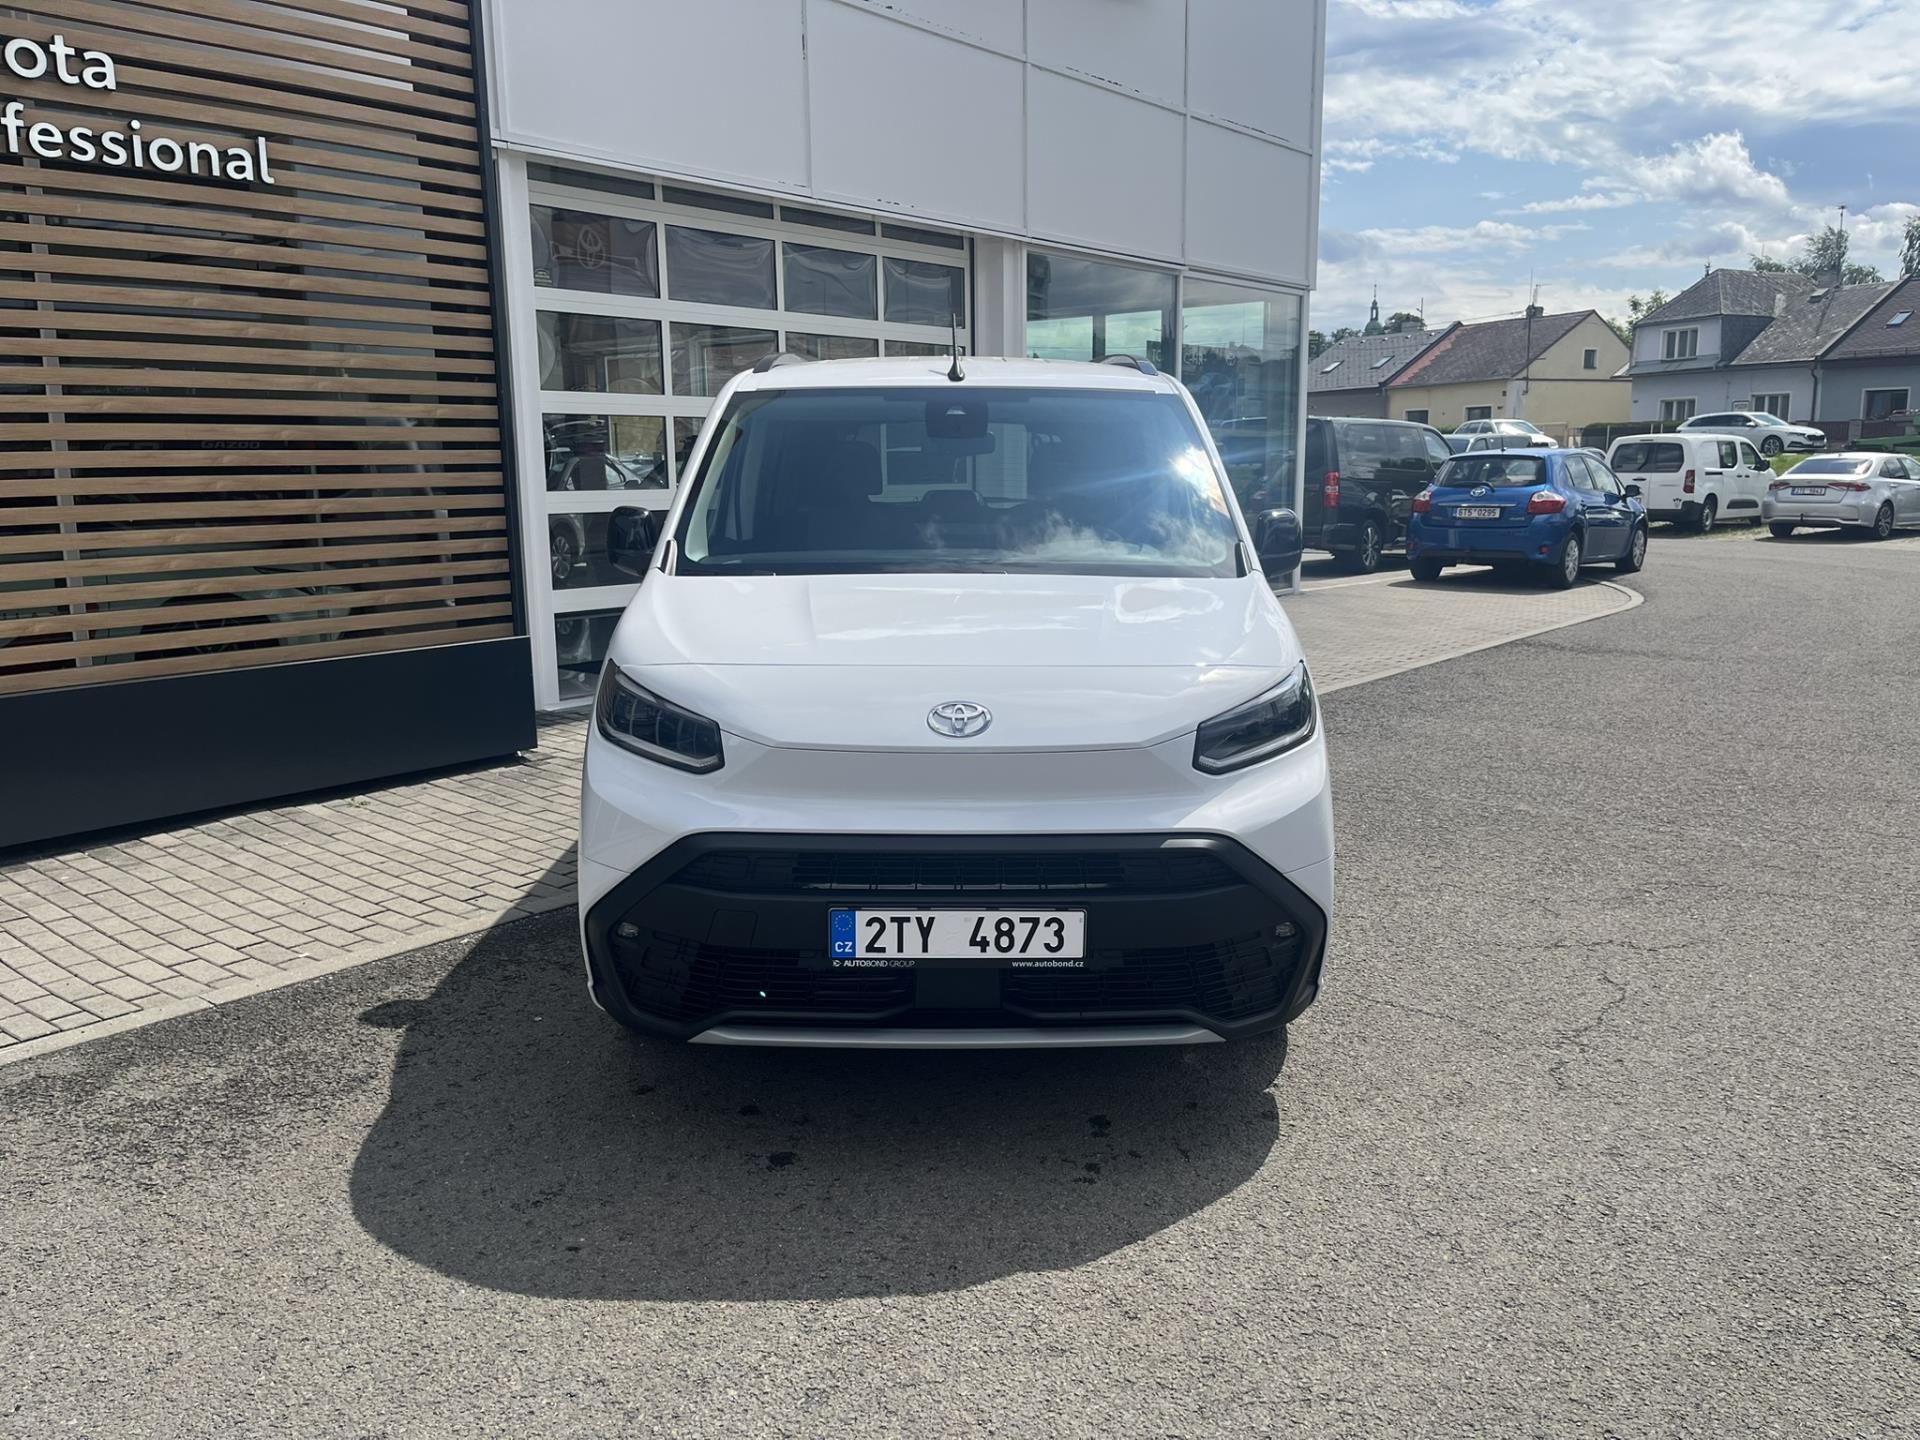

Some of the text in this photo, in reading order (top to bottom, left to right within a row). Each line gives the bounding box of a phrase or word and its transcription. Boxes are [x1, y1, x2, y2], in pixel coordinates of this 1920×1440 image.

[4, 35, 117, 90] ota
[0, 102, 274, 184] fessional
[865, 916, 1065, 953] 2TY 4873
[834, 941, 853, 953] CZ
[843, 960, 916, 968] AUTOBOND GROUP
[1011, 960, 1085, 968] www.autobond.cz
